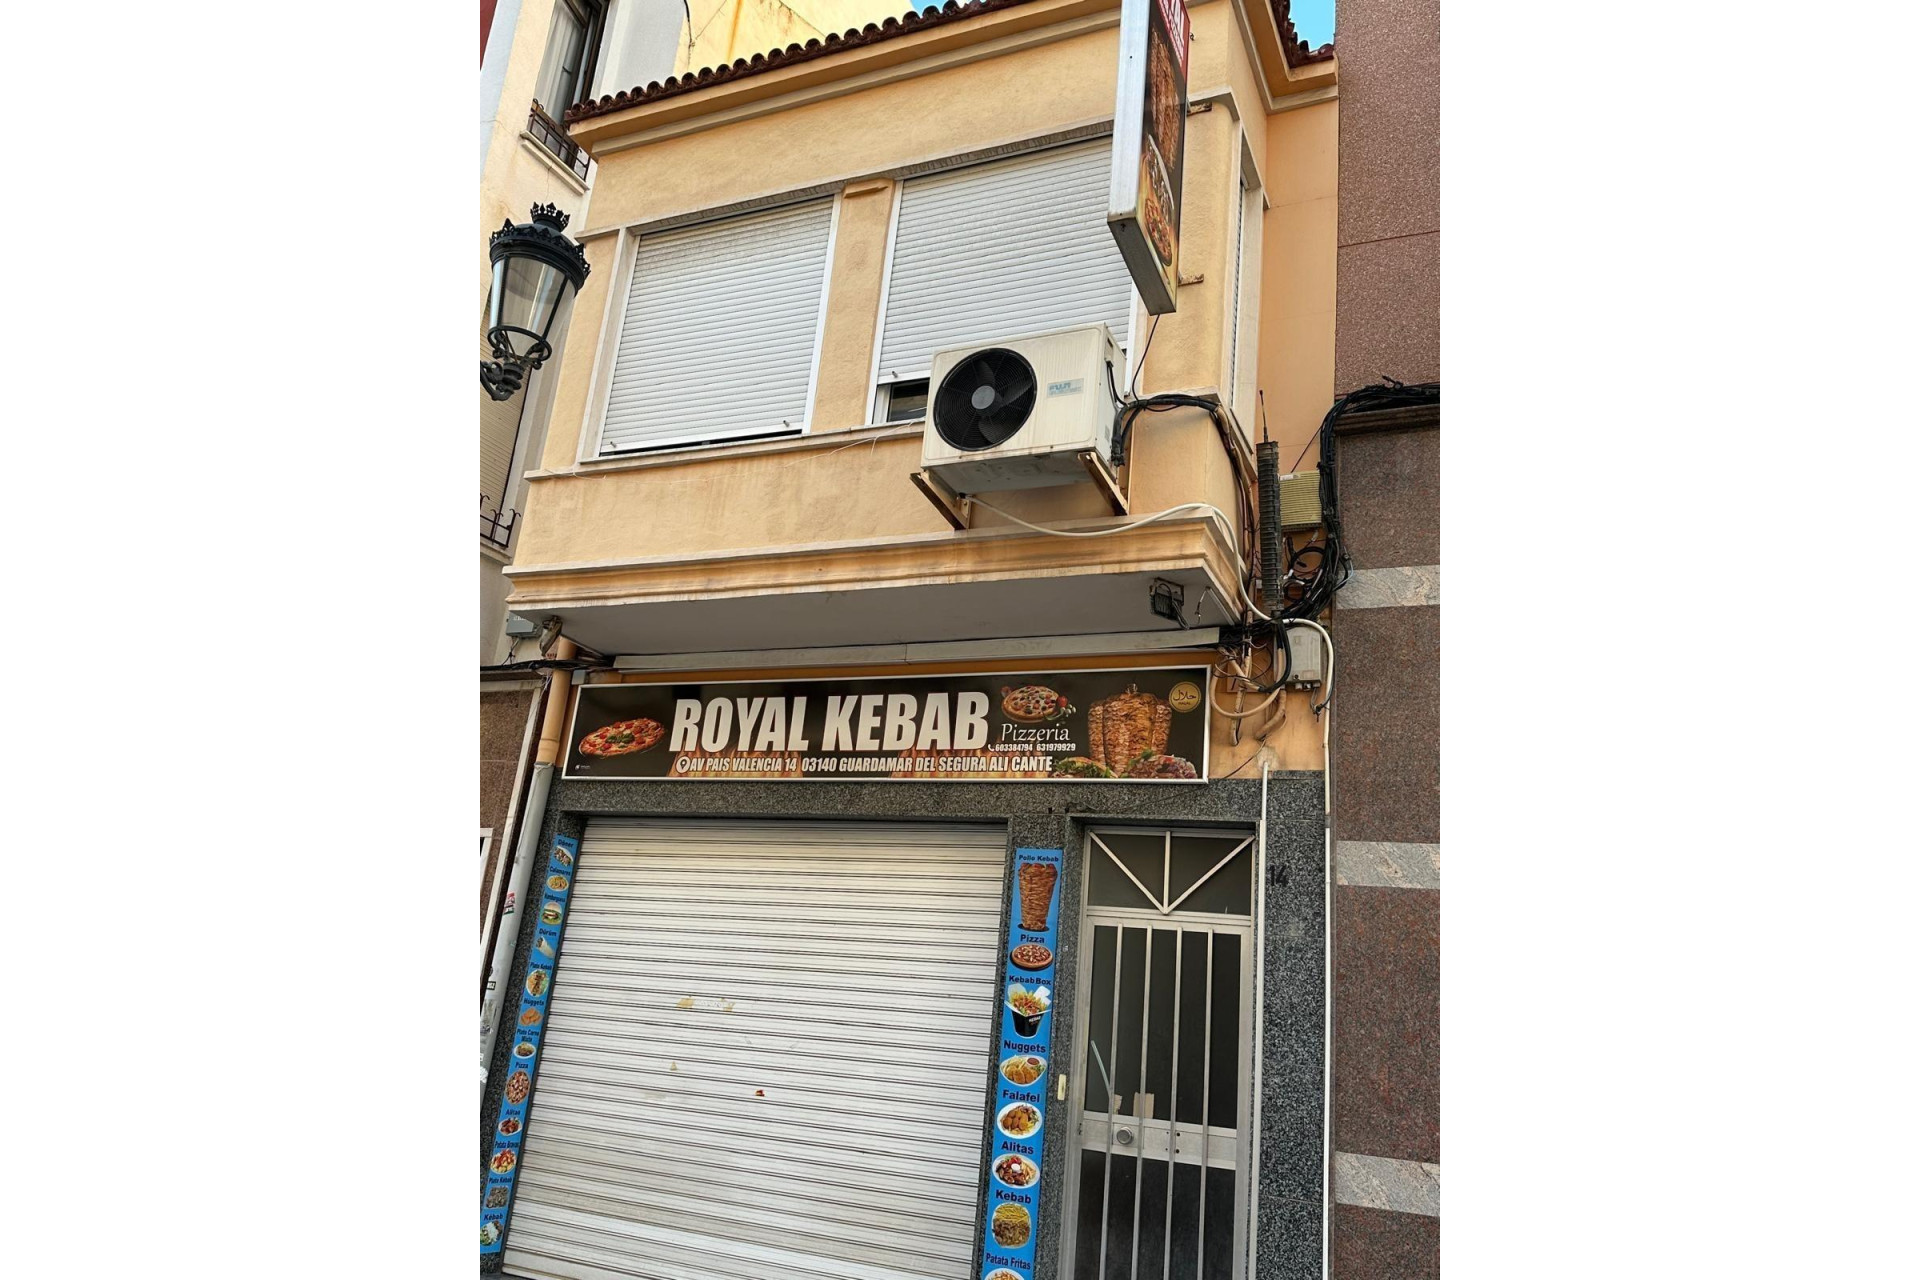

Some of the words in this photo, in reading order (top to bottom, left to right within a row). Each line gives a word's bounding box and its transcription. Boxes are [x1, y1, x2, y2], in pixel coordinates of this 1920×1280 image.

[1173, 690, 1197, 701] حلال
[669, 696, 809, 752] ROYAL
[821, 692, 990, 751] KEBAB
[1001, 723, 1070, 742] Pizzeria
[1036, 742, 1076, 752] 631979929
[690, 757, 705, 772] AV
[705, 757, 730, 772] PAIS
[732, 757, 782, 772] VALENCIA
[785, 757, 797, 772] 14
[802, 757, 837, 772] 03140
[838, 757, 913, 772] GUARDAMAR
[914, 757, 936, 772] DEL
[938, 756, 988, 772] SEGURA
[988, 756, 1009, 772] ALI
[1011, 756, 1052, 772] CANTE
[1269, 864, 1289, 887] 14
[1020, 934, 1045, 943] Pizza
[1003, 1040, 1047, 1053] Nuggets
[1002, 1089, 1041, 1103] Falafel
[1001, 1141, 1034, 1155] Alitas
[995, 1189, 1031, 1204] Kebab
[484, 1213, 504, 1221] Kebab
[985, 1252, 1008, 1266] Patata
[1010, 1257, 1031, 1270] Fritas
